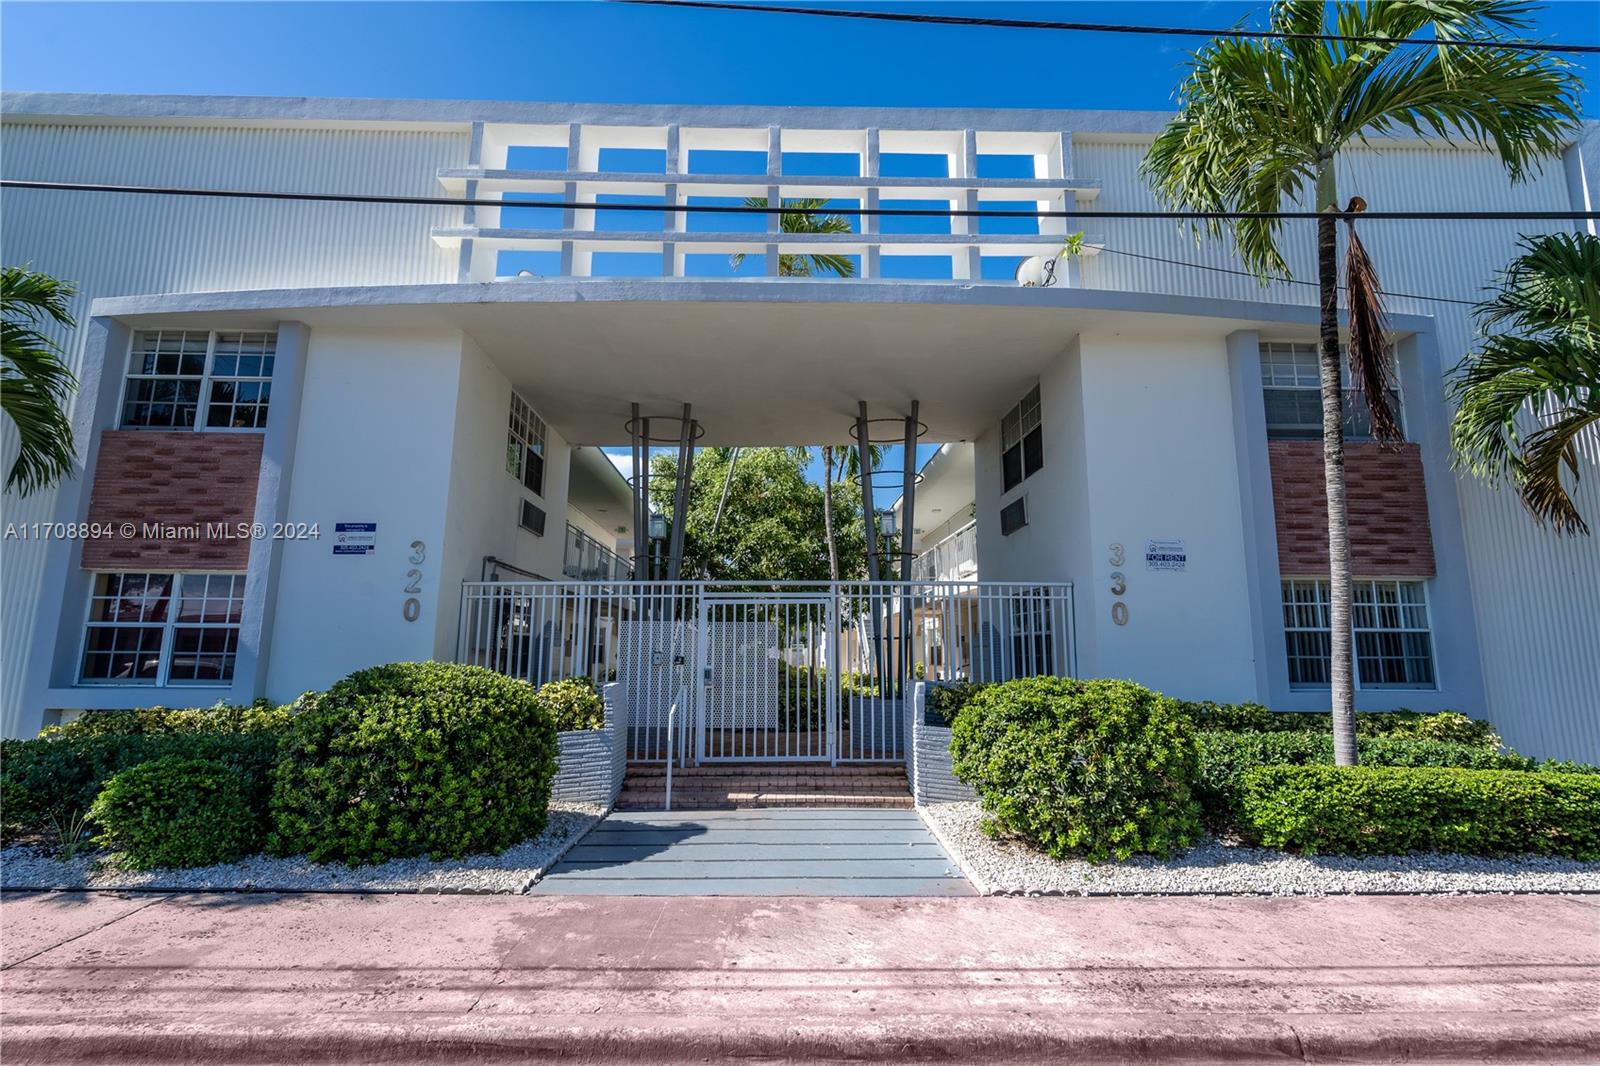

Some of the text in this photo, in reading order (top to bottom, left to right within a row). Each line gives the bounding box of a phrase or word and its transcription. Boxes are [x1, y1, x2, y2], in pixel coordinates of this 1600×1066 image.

[403, 540, 426, 623] 320
[1109, 543, 1129, 626] 330
[1165, 554, 1185, 562] RENT
